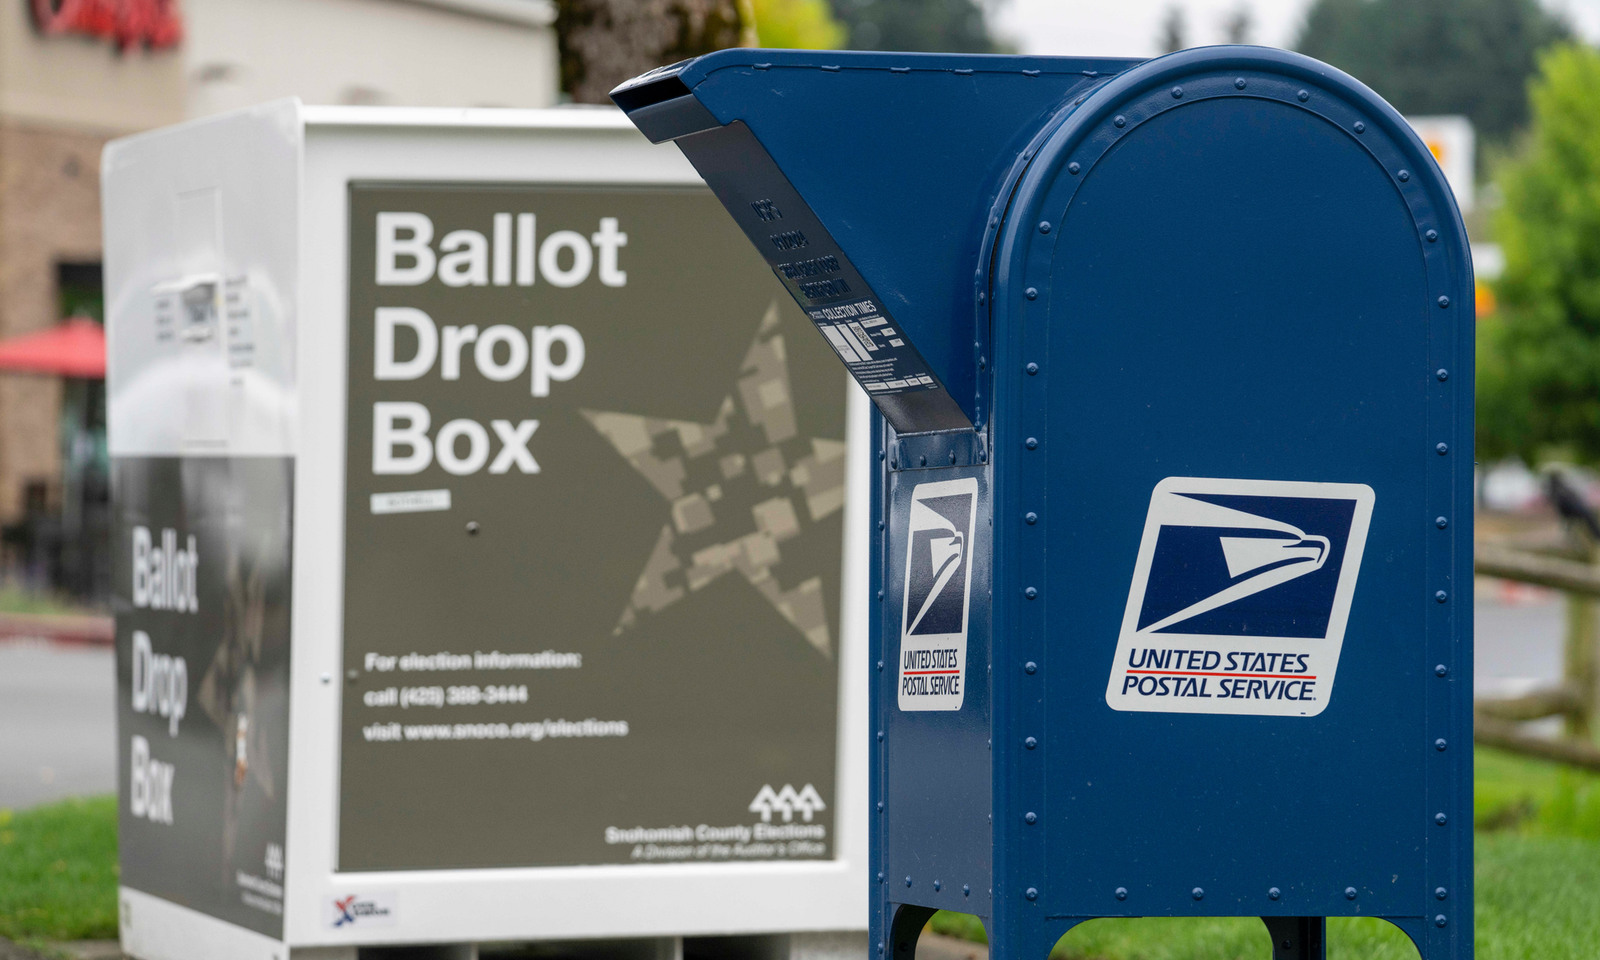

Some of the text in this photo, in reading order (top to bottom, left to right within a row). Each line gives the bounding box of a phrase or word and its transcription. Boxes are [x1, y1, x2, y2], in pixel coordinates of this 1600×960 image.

[750, 198, 783, 223] USPS
[374, 211, 628, 288] Ballot
[822, 303, 859, 320] COLLECTION
[854, 300, 877, 315] TIMES
[373, 306, 586, 397] Drop
[372, 401, 541, 475] Box
[132, 525, 199, 614] Ballot
[364, 650, 582, 672] For election information:
[903, 648, 958, 669] UNITED STATES
[1128, 648, 1310, 673] UNITED STATES
[132, 630, 188, 738] Drop
[902, 676, 929, 696] POSTAL
[1122, 675, 1212, 698] POSTAL
[363, 687, 399, 707] call
[362, 722, 402, 742] visit
[131, 735, 175, 826] Box
[605, 822, 826, 845] Snohomish County Elections
